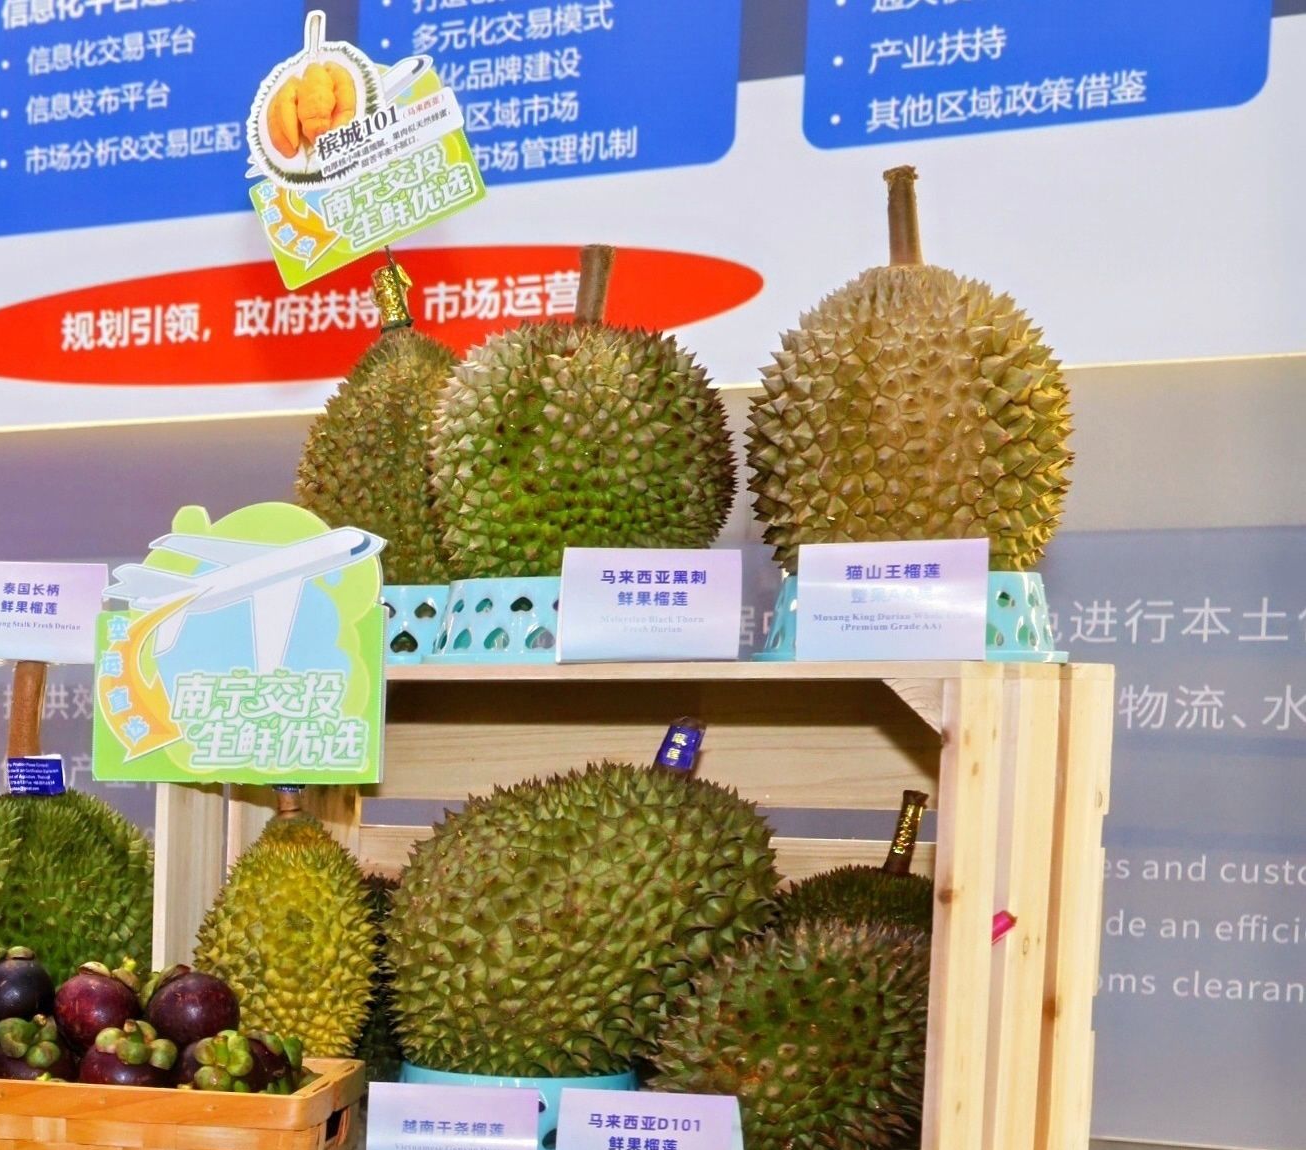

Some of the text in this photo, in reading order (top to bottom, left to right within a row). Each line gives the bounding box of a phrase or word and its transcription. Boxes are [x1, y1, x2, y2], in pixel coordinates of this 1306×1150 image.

[27, 24, 196, 75] 信息化交易平台
[412, 1, 615, 53] 多元化交易模式
[867, 25, 1007, 74] 产业扶持
[26, 79, 171, 125] 信息发布平台
[866, 69, 1147, 134] 其他区域政策借鉴
[25, 122, 242, 174] 市场分析&交易匹配
[316, 105, 400, 161] 槟城101
[321, 142, 446, 227] 南宁交投
[348, 167, 474, 249] 生鲜优选
[3, 582, 60, 596] 泰国长柄
[600, 570, 707, 585] 马来西亚黑刺
[846, 563, 942, 580] 猫山王榴莲
[1, 600, 58, 615] 鲜果榴莲
[617, 591, 689, 608] 鲜果榴莲
[840, 623, 921, 632] (Premium Grade
[172, 669, 346, 721] 南宁交投
[189, 718, 369, 770] 生鲜优选
[1141, 853, 1207, 882] and
[1159, 917, 1200, 939] an
[401, 1120, 505, 1136] 越南干尧榴莲
[588, 1113, 702, 1132] 马来西亚D101
